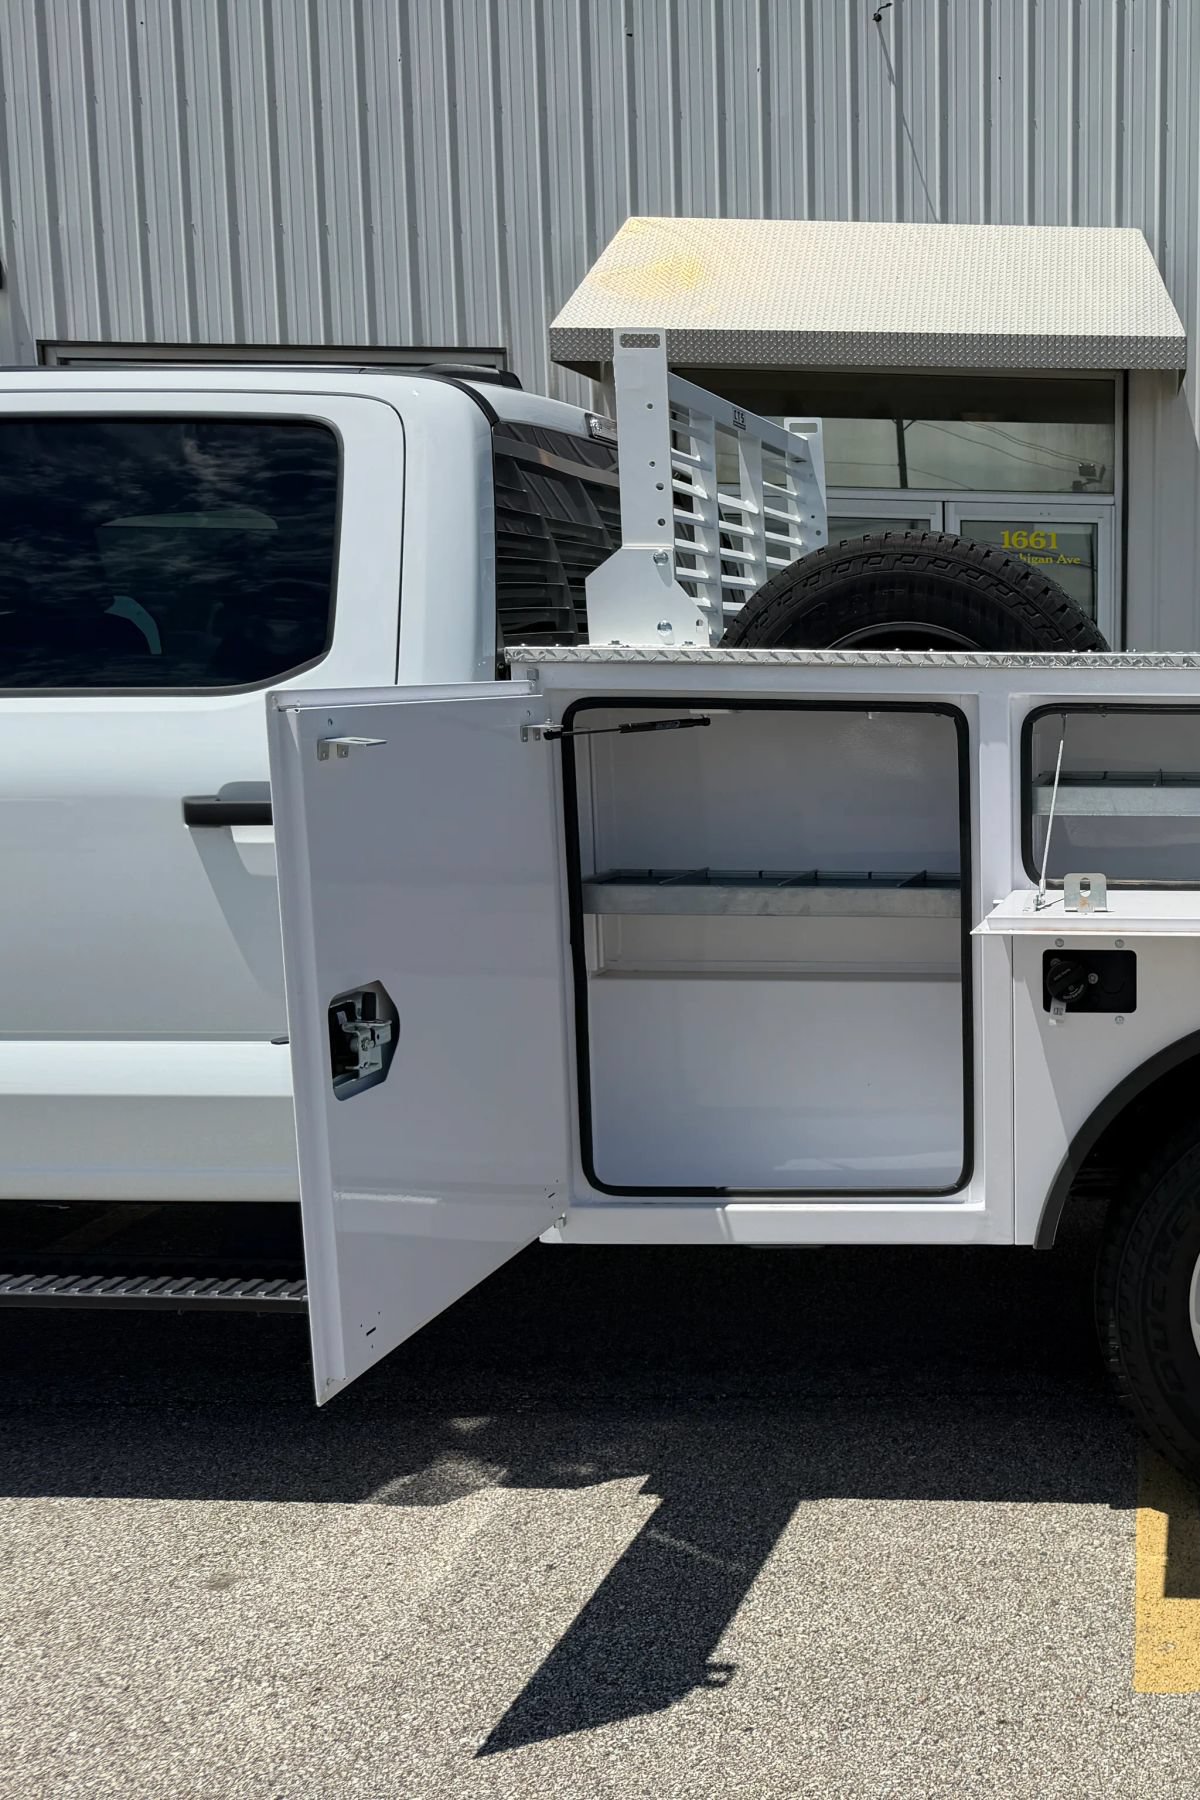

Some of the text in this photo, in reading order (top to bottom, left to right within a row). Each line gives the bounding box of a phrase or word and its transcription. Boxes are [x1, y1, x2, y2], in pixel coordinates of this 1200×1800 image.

[1000, 530, 1057, 549] 1661
[1019, 553, 1081, 566] higan Ave
